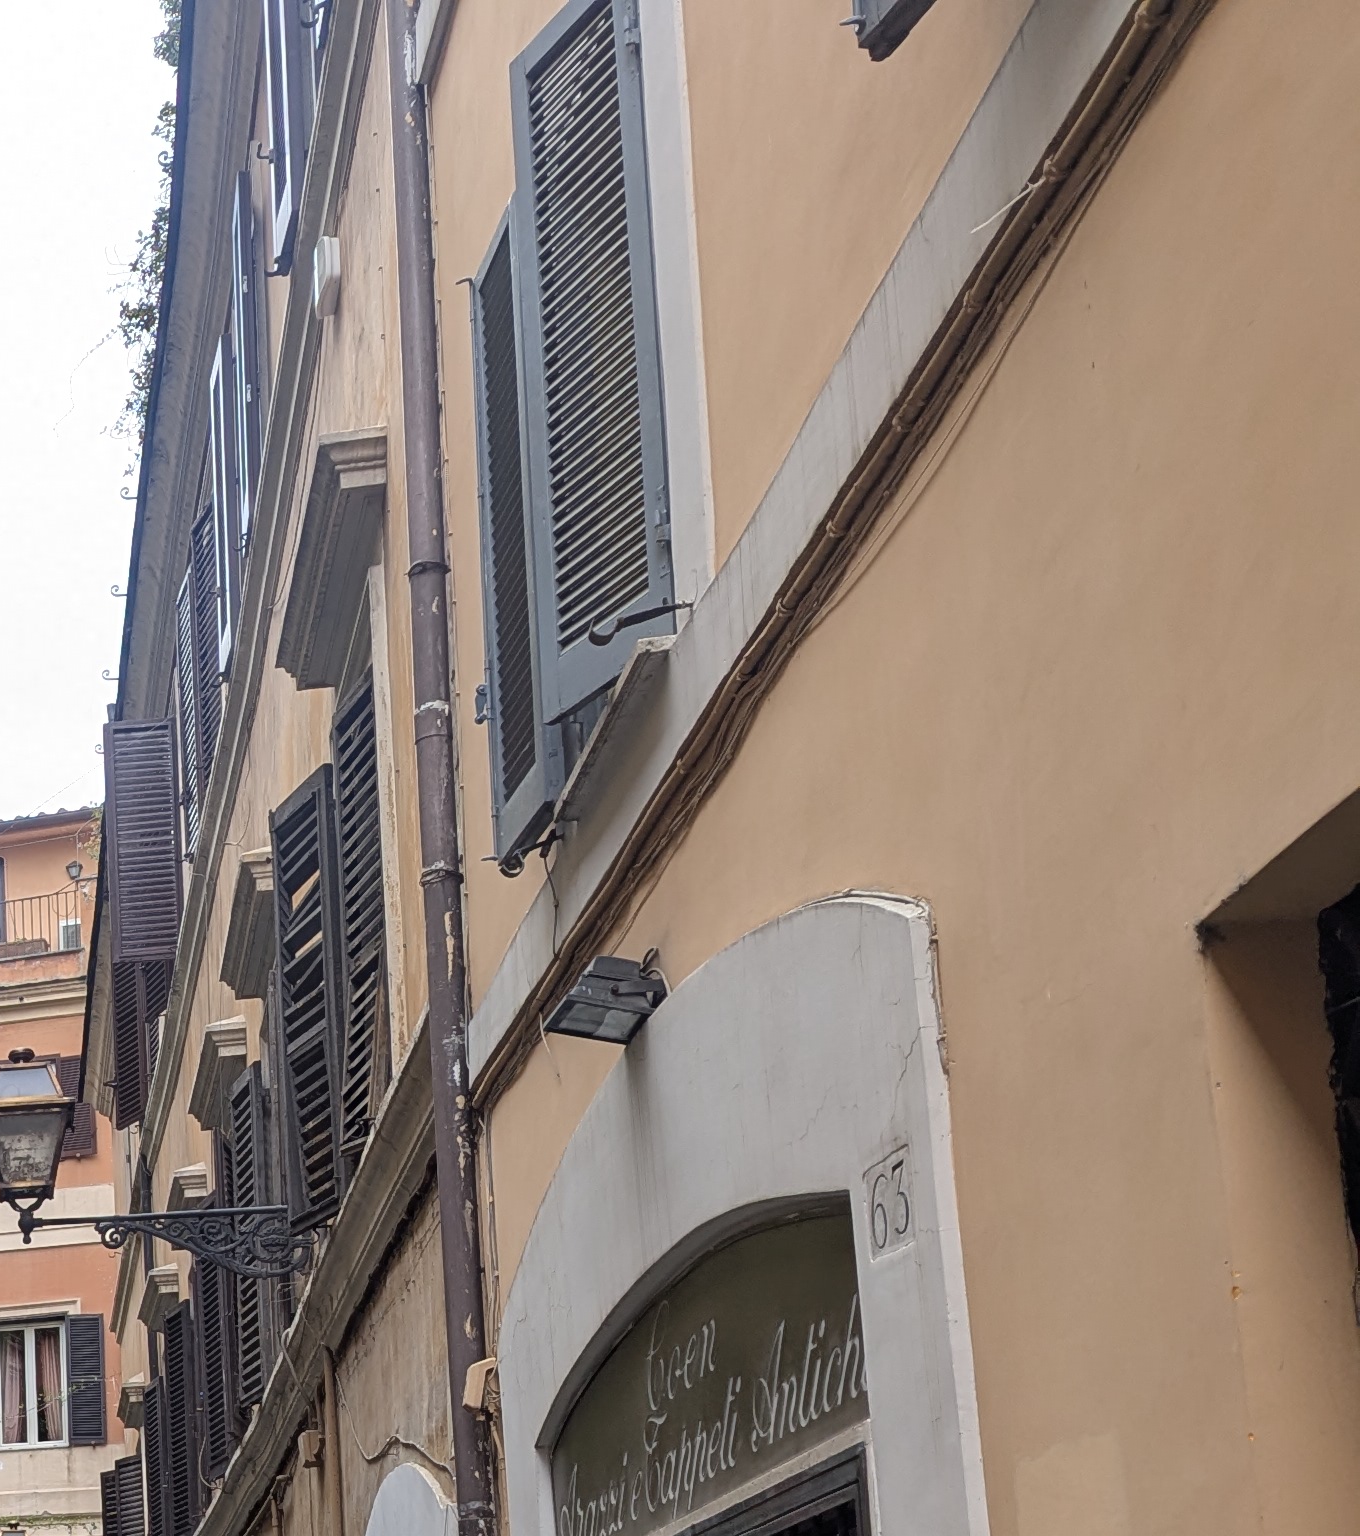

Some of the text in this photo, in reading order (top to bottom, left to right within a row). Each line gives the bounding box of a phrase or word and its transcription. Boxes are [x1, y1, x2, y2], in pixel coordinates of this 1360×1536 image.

[871, 1158, 909, 1249] 63
[647, 1300, 715, 1410] Coen
[631, 1471, 643, 1521] e
